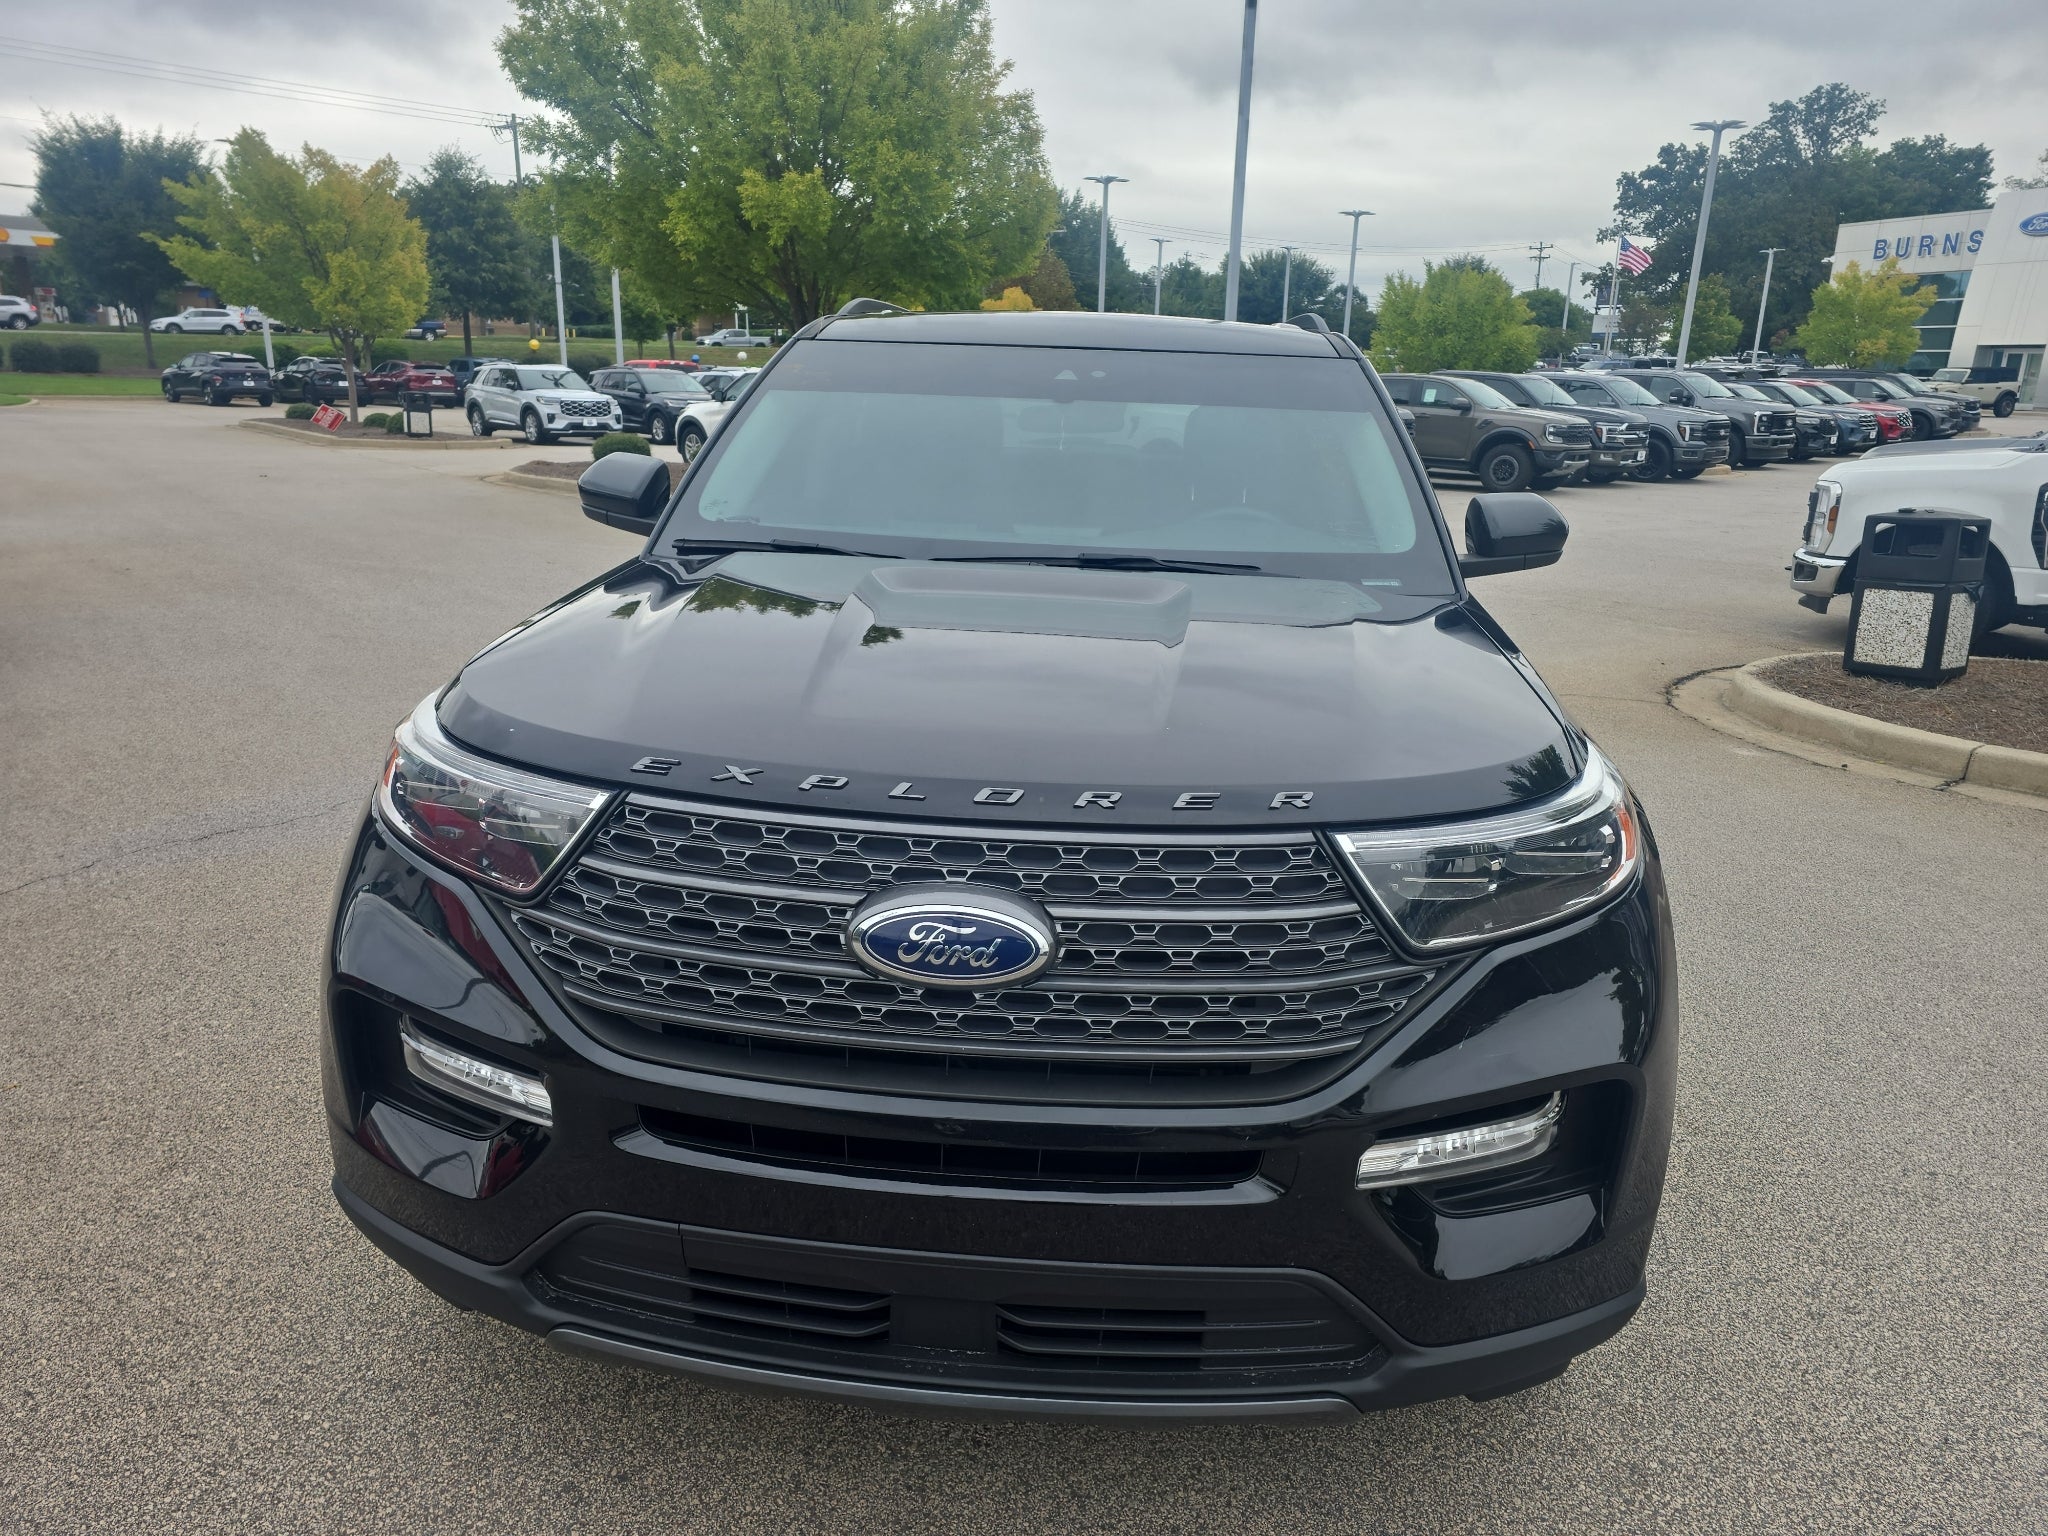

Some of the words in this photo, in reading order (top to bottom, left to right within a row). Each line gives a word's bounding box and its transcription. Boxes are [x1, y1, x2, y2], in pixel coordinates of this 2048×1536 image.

[1873, 229, 1985, 260] BURNS
[631, 756, 1316, 811] EXPLORER
[898, 921, 1001, 968] Ford
